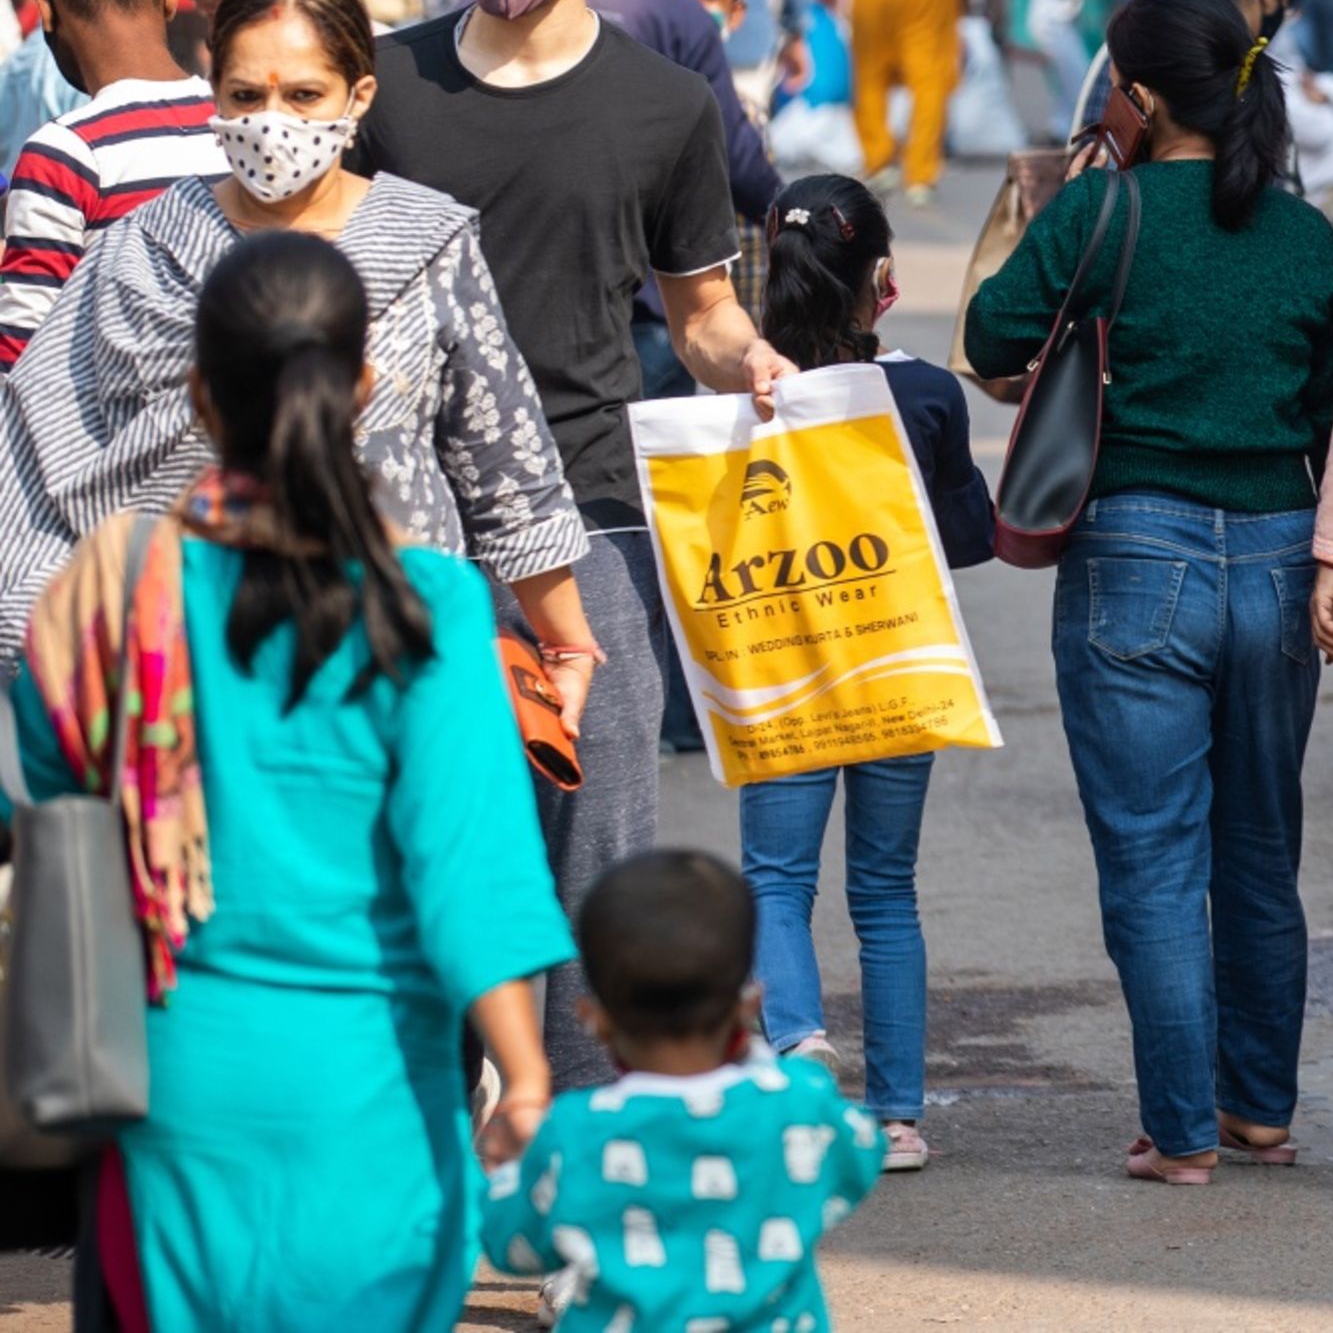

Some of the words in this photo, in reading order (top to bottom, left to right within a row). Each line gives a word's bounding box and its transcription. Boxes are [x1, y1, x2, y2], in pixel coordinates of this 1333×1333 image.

[695, 532, 889, 604] Arzoo
[716, 598, 801, 629] Ethnic
[814, 584, 878, 608] Wear
[855, 612, 919, 636] SHERWANI
